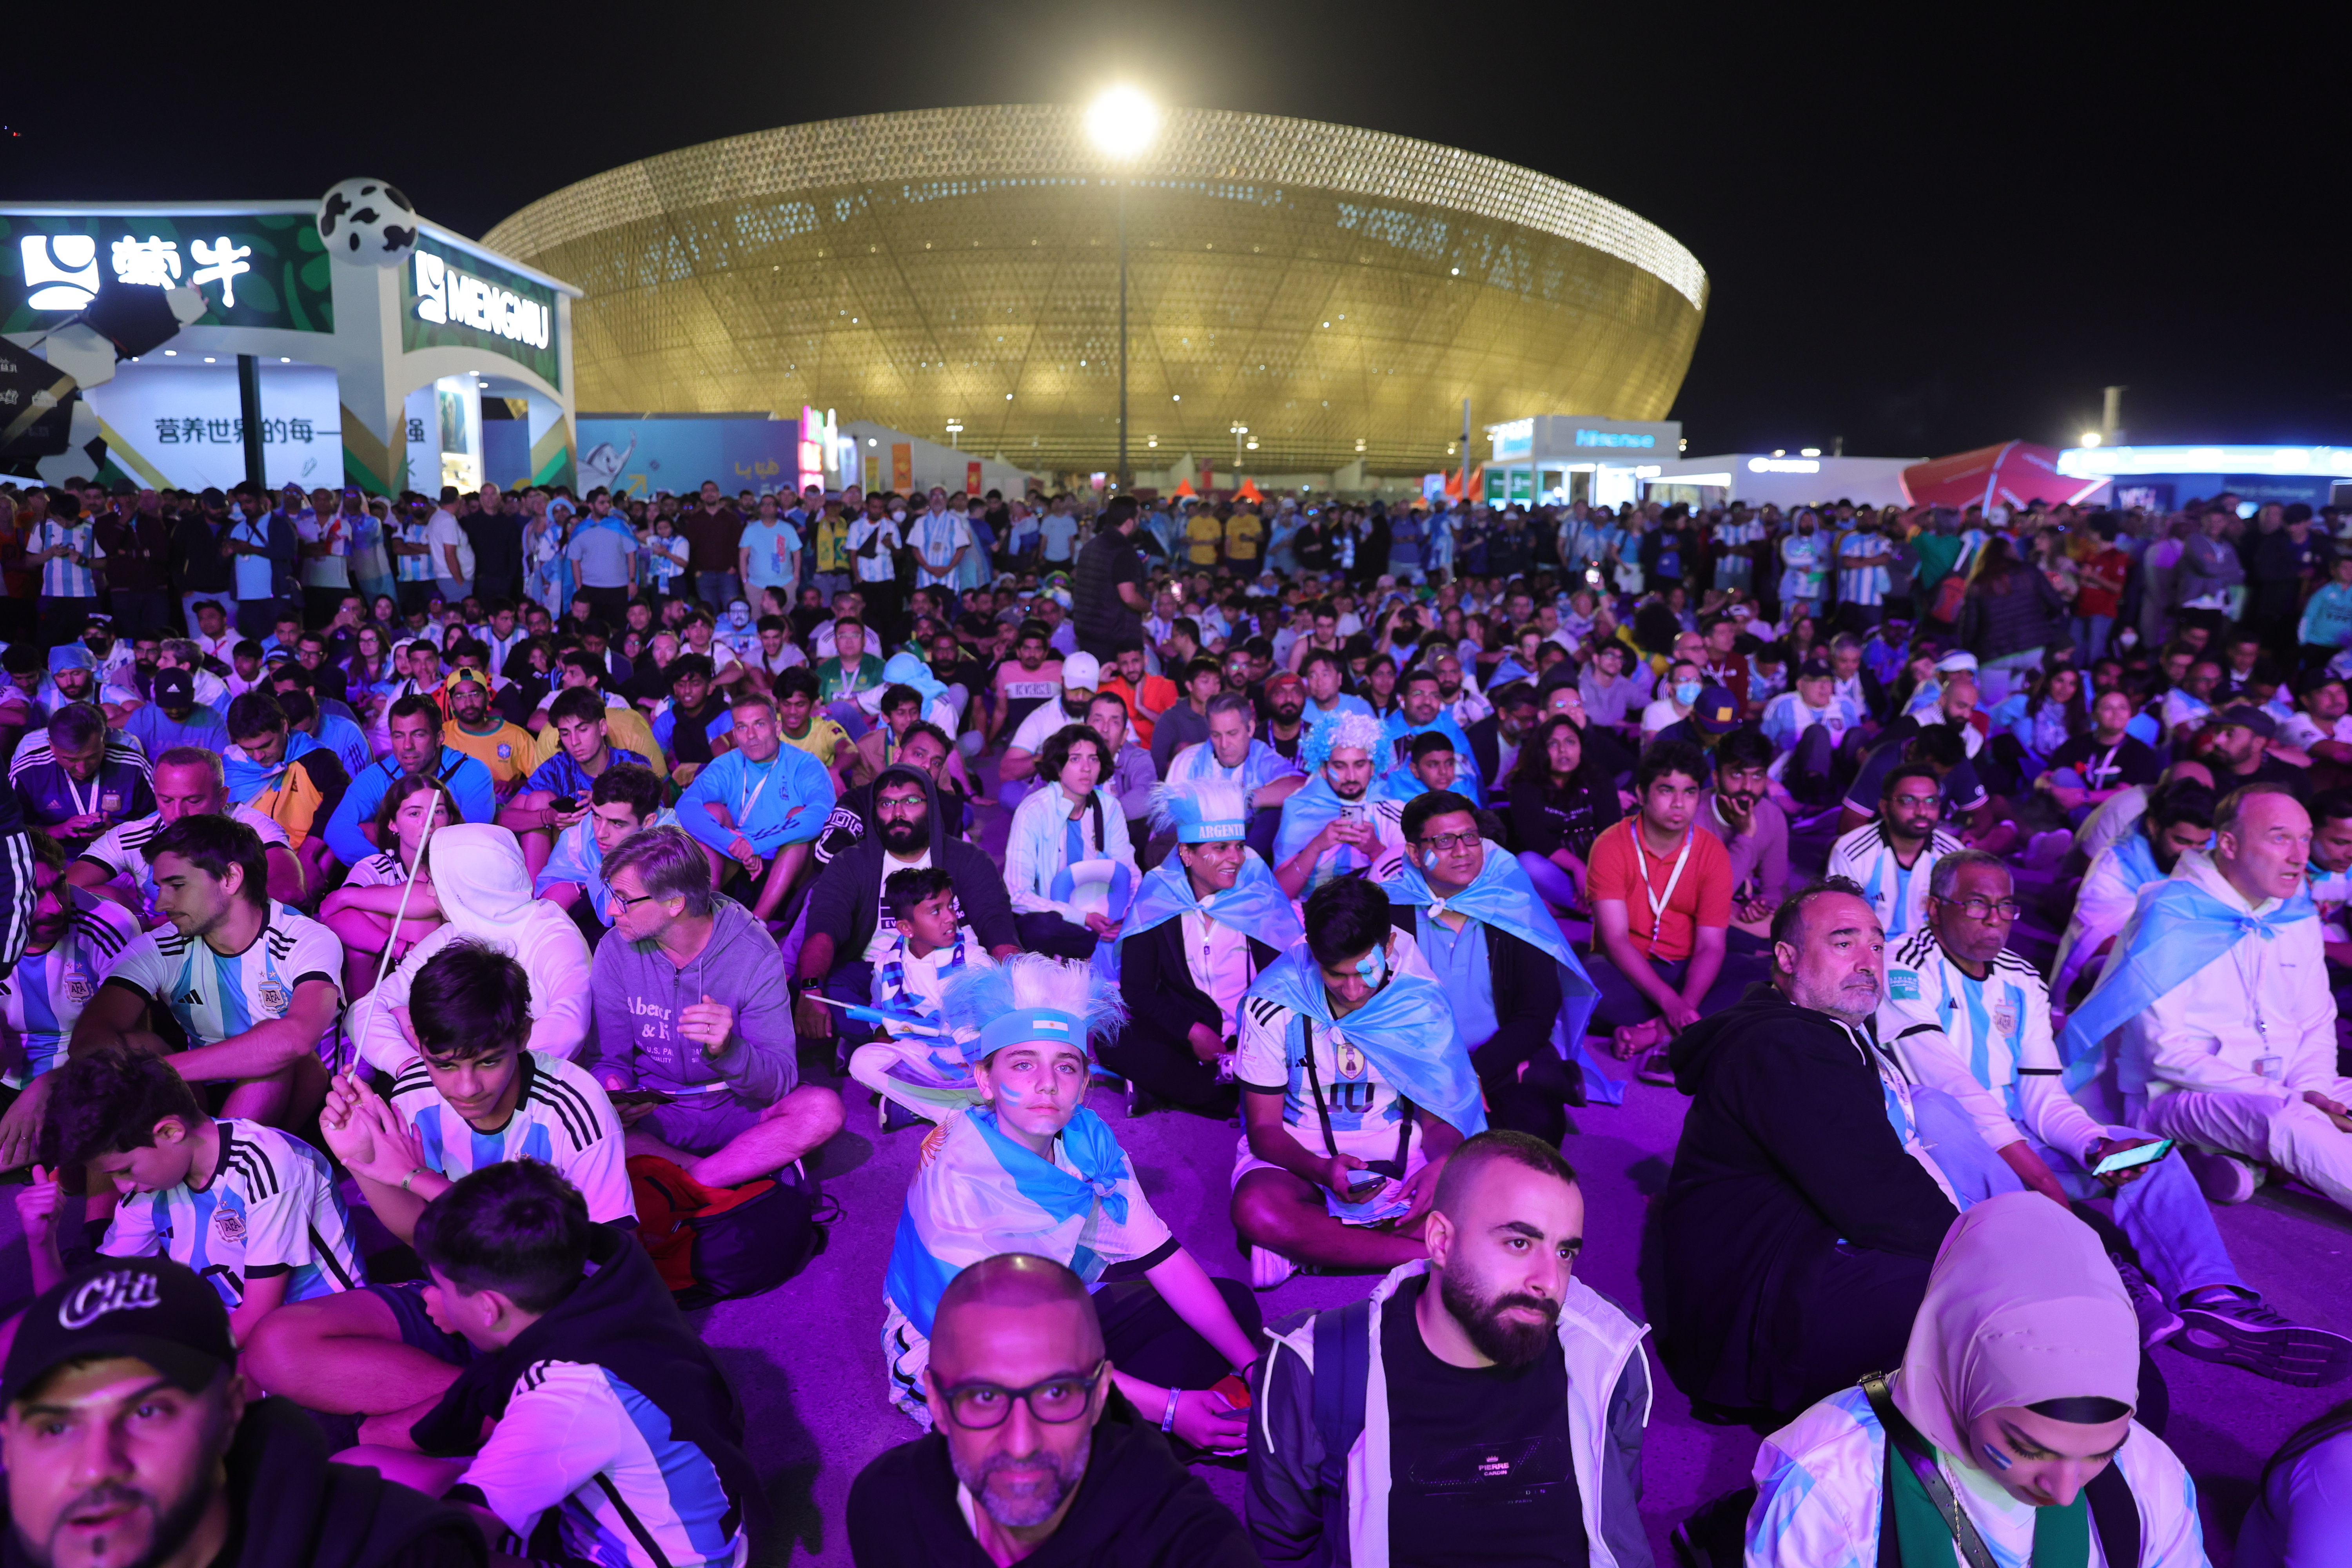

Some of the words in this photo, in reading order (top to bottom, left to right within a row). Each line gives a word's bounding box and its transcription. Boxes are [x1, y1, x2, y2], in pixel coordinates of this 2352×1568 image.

[111, 235, 251, 308] 蒙牛
[447, 270, 548, 349] MENGNIU
[1575, 428, 1655, 448] Hisense
[266, 990, 280, 1003] AFA
[642, 1024, 656, 1038] &
[225, 1218, 241, 1232] AFA
[1478, 1462, 1510, 1471] PIERRE
